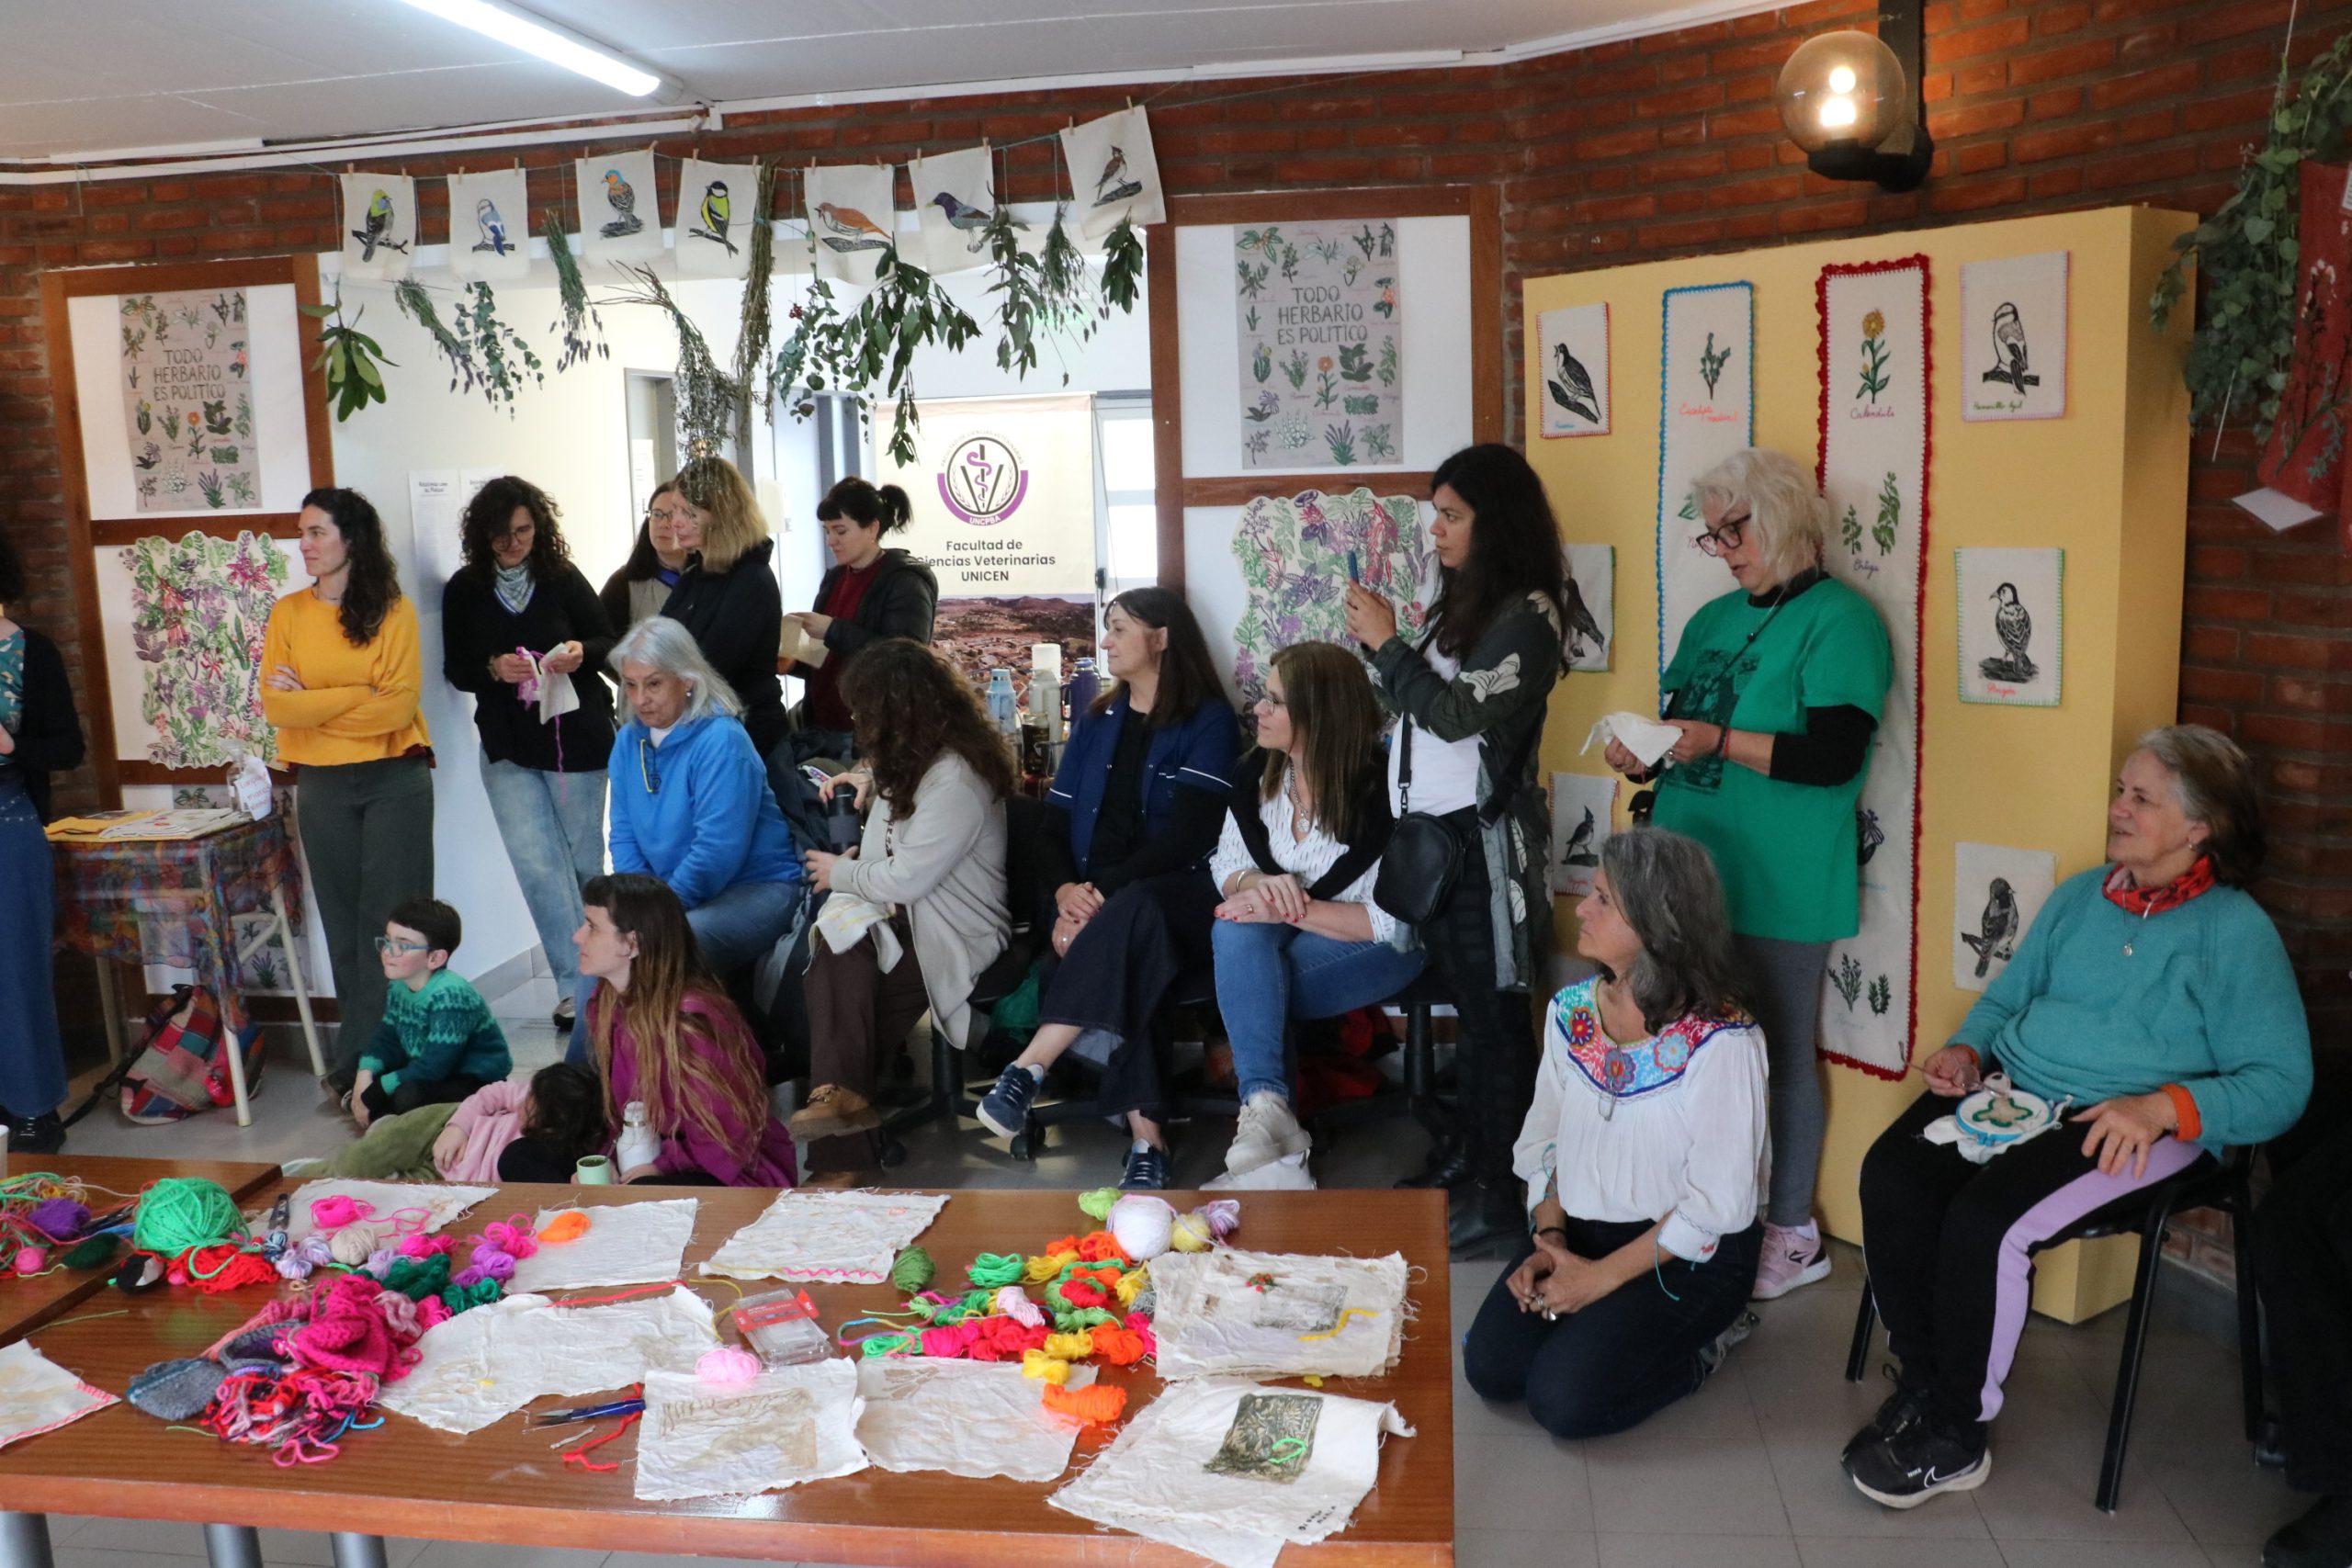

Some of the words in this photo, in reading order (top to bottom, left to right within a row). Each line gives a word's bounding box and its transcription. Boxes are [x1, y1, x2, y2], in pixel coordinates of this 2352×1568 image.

[1292, 285, 1340, 304] TODO
[1278, 303, 1363, 325] HERBARIO
[1277, 327, 1295, 345] ES
[163, 348, 203, 365] TODO
[153, 365, 221, 383] HERBARIO
[153, 386, 169, 401] ES
[969, 514, 1001, 526] UNCPBA
[946, 539, 1003, 551] Facultad
[1006, 539, 1023, 550] de
[974, 554, 1056, 567] Veterinarias
[961, 570, 1010, 581] UNICEN
